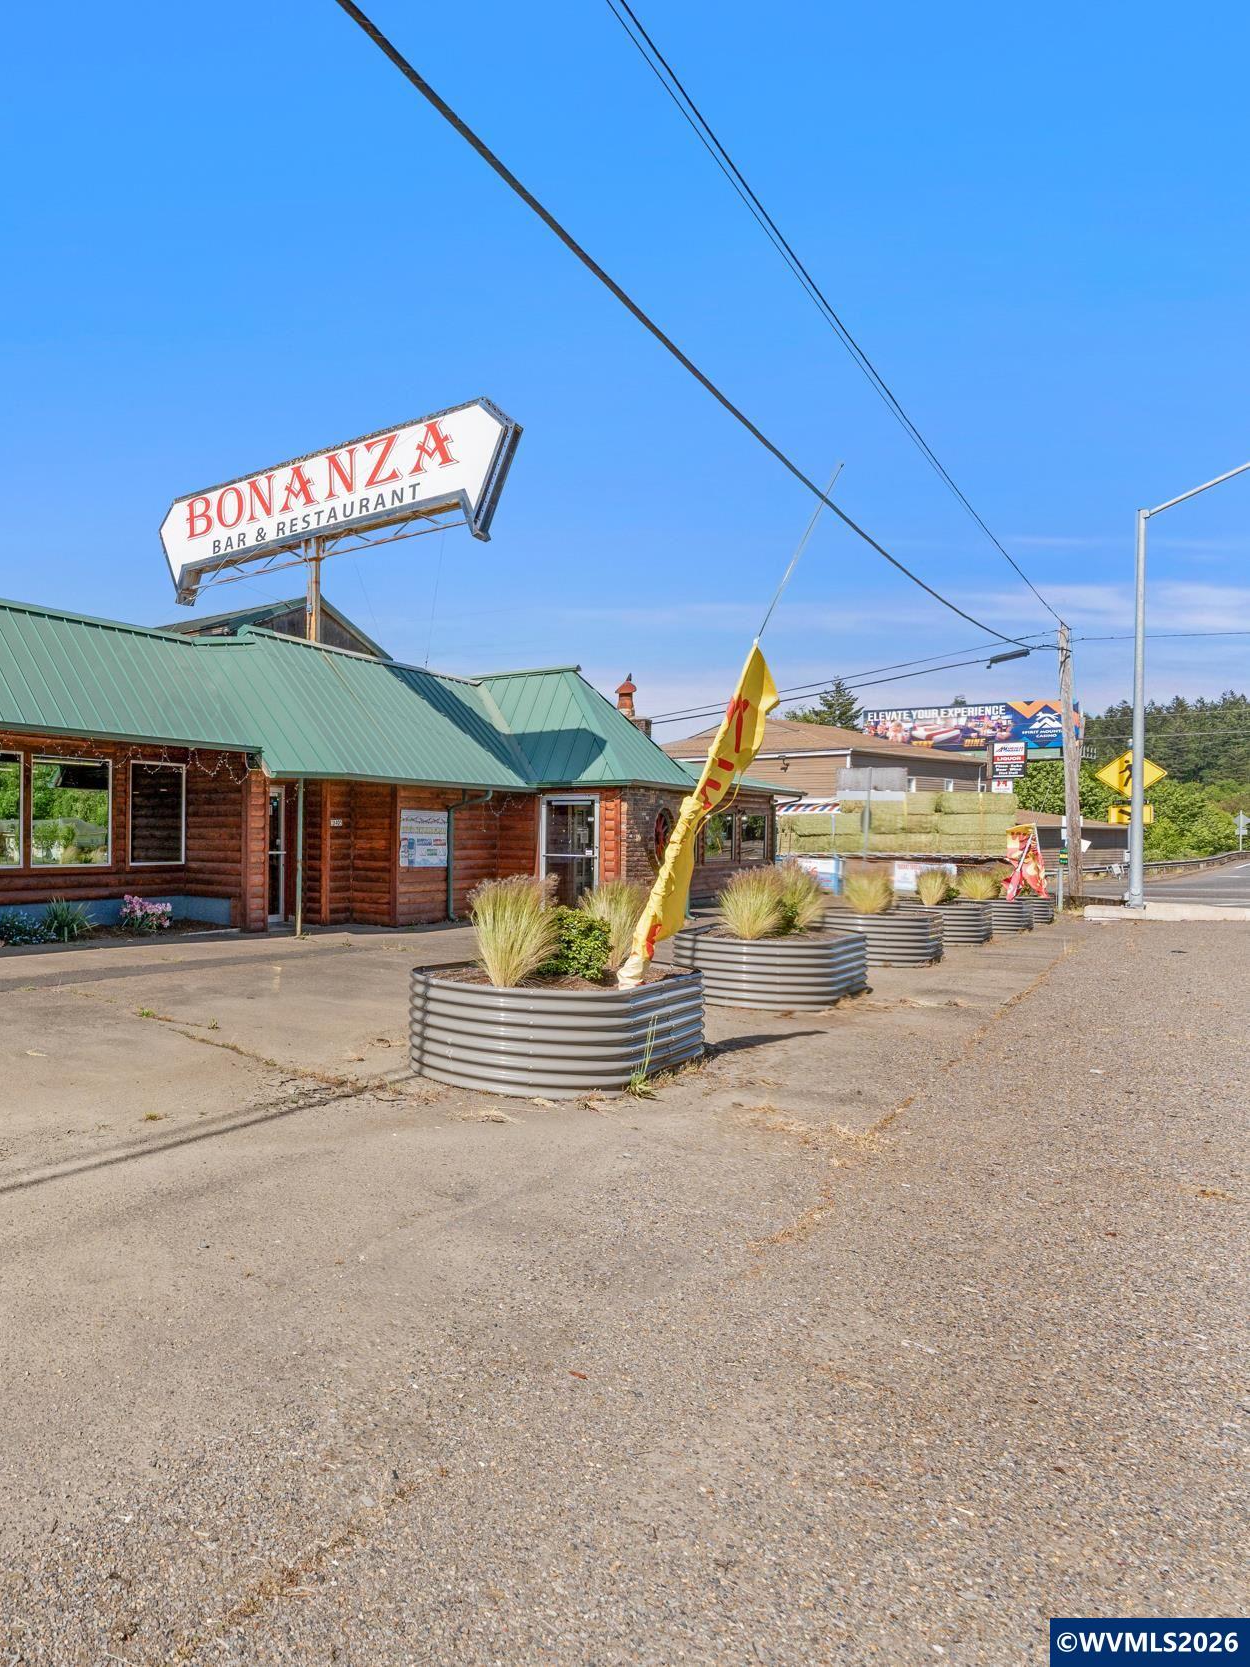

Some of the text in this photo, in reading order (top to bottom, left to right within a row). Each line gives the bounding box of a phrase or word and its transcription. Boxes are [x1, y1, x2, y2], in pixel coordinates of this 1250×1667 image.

[186, 418, 460, 541] BONANZA
[212, 482, 421, 555] BAR & RESTAURANT
[867, 705, 1006, 721] ELEVATE YOUR EXPERIENCE
[963, 738, 986, 748] DINE
